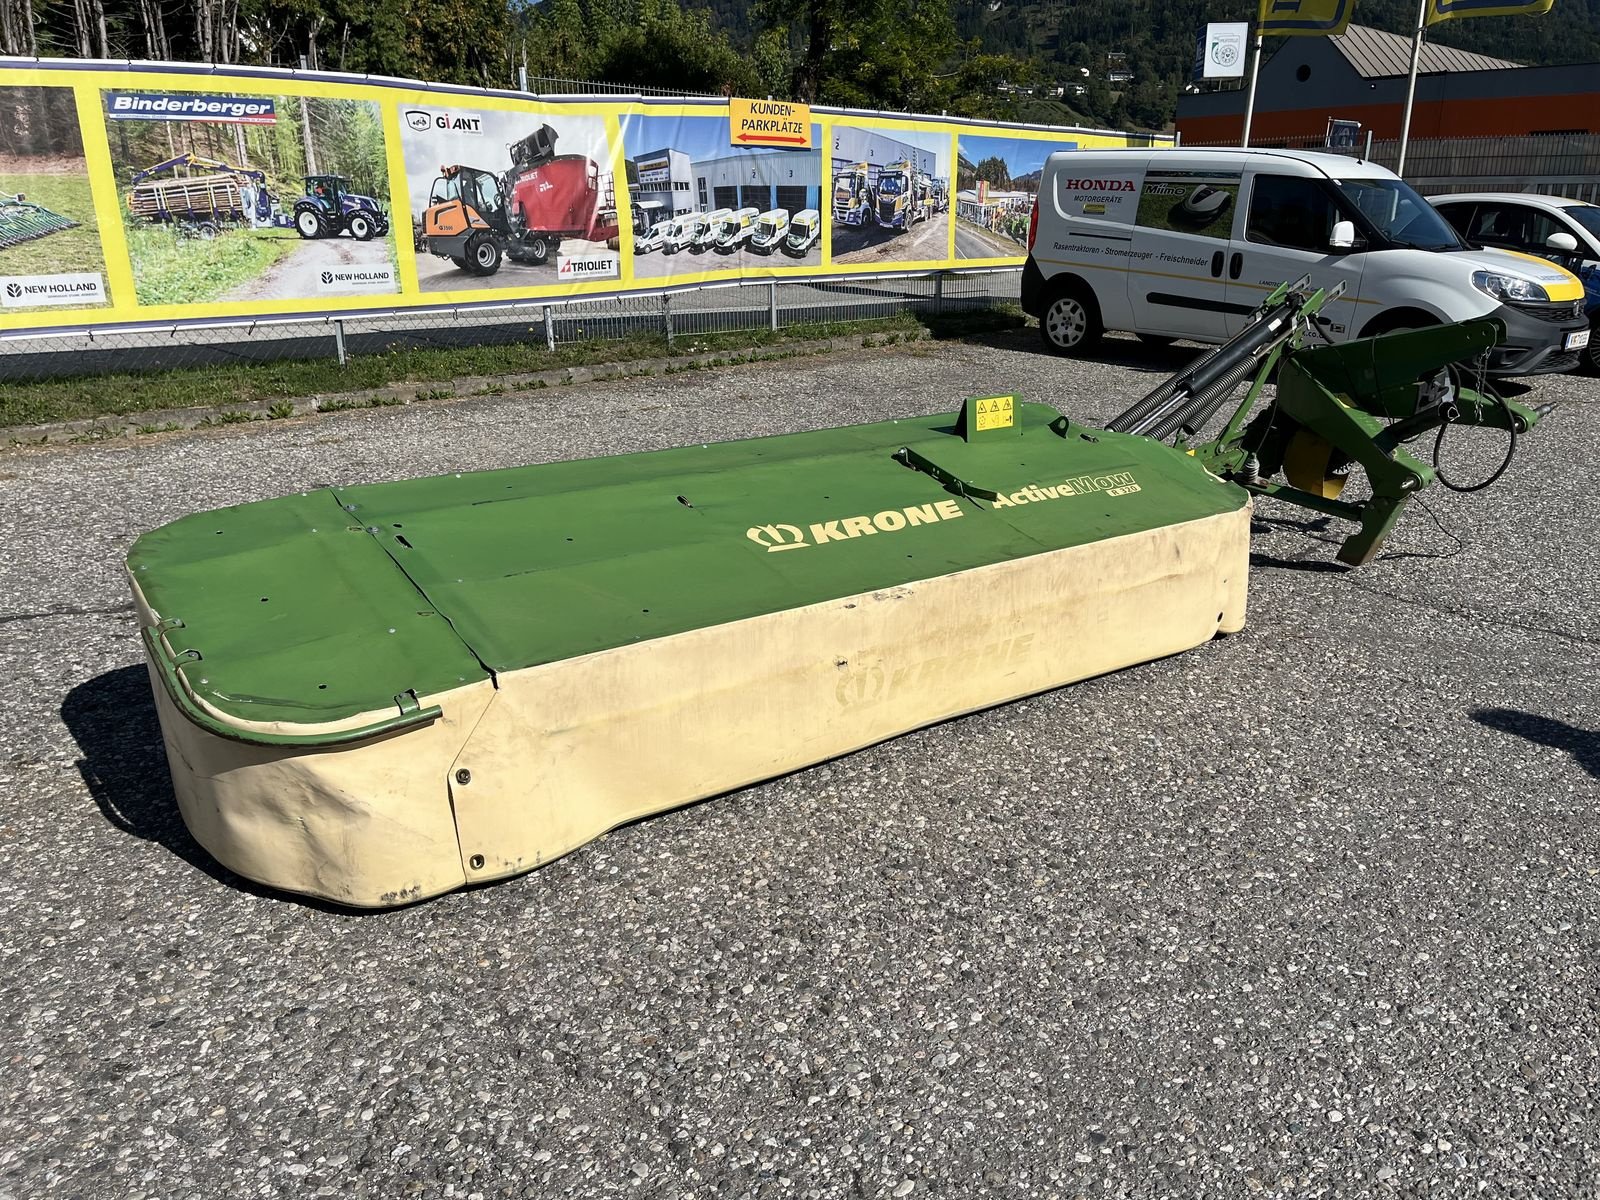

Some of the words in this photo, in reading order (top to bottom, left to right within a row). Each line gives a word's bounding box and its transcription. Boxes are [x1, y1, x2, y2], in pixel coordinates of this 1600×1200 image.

[114, 96, 270, 116] Binderberger
[750, 102, 796, 117] KUNDEN-
[741, 117, 803, 134] PARKPLÄTZE
[1065, 179, 1136, 192] HONDA
[1144, 183, 1186, 196] Miimo
[1073, 195, 1124, 204] MOTORGERÄTE
[1053, 241, 1101, 255] Rasentraktoren
[1105, 246, 1153, 261] Stromerzeuger
[1159, 252, 1209, 267] Freischneider
[334, 273, 353, 281] NEW
[353, 272, 390, 281] HOLLAND
[24, 285, 47, 294] NEW
[49, 282, 97, 293] HOLLAND
[991, 471, 1136, 509] ActiveMow
[1110, 489, 1119, 497] R
[1121, 485, 1139, 495] 320
[809, 499, 964, 545] KRONE
